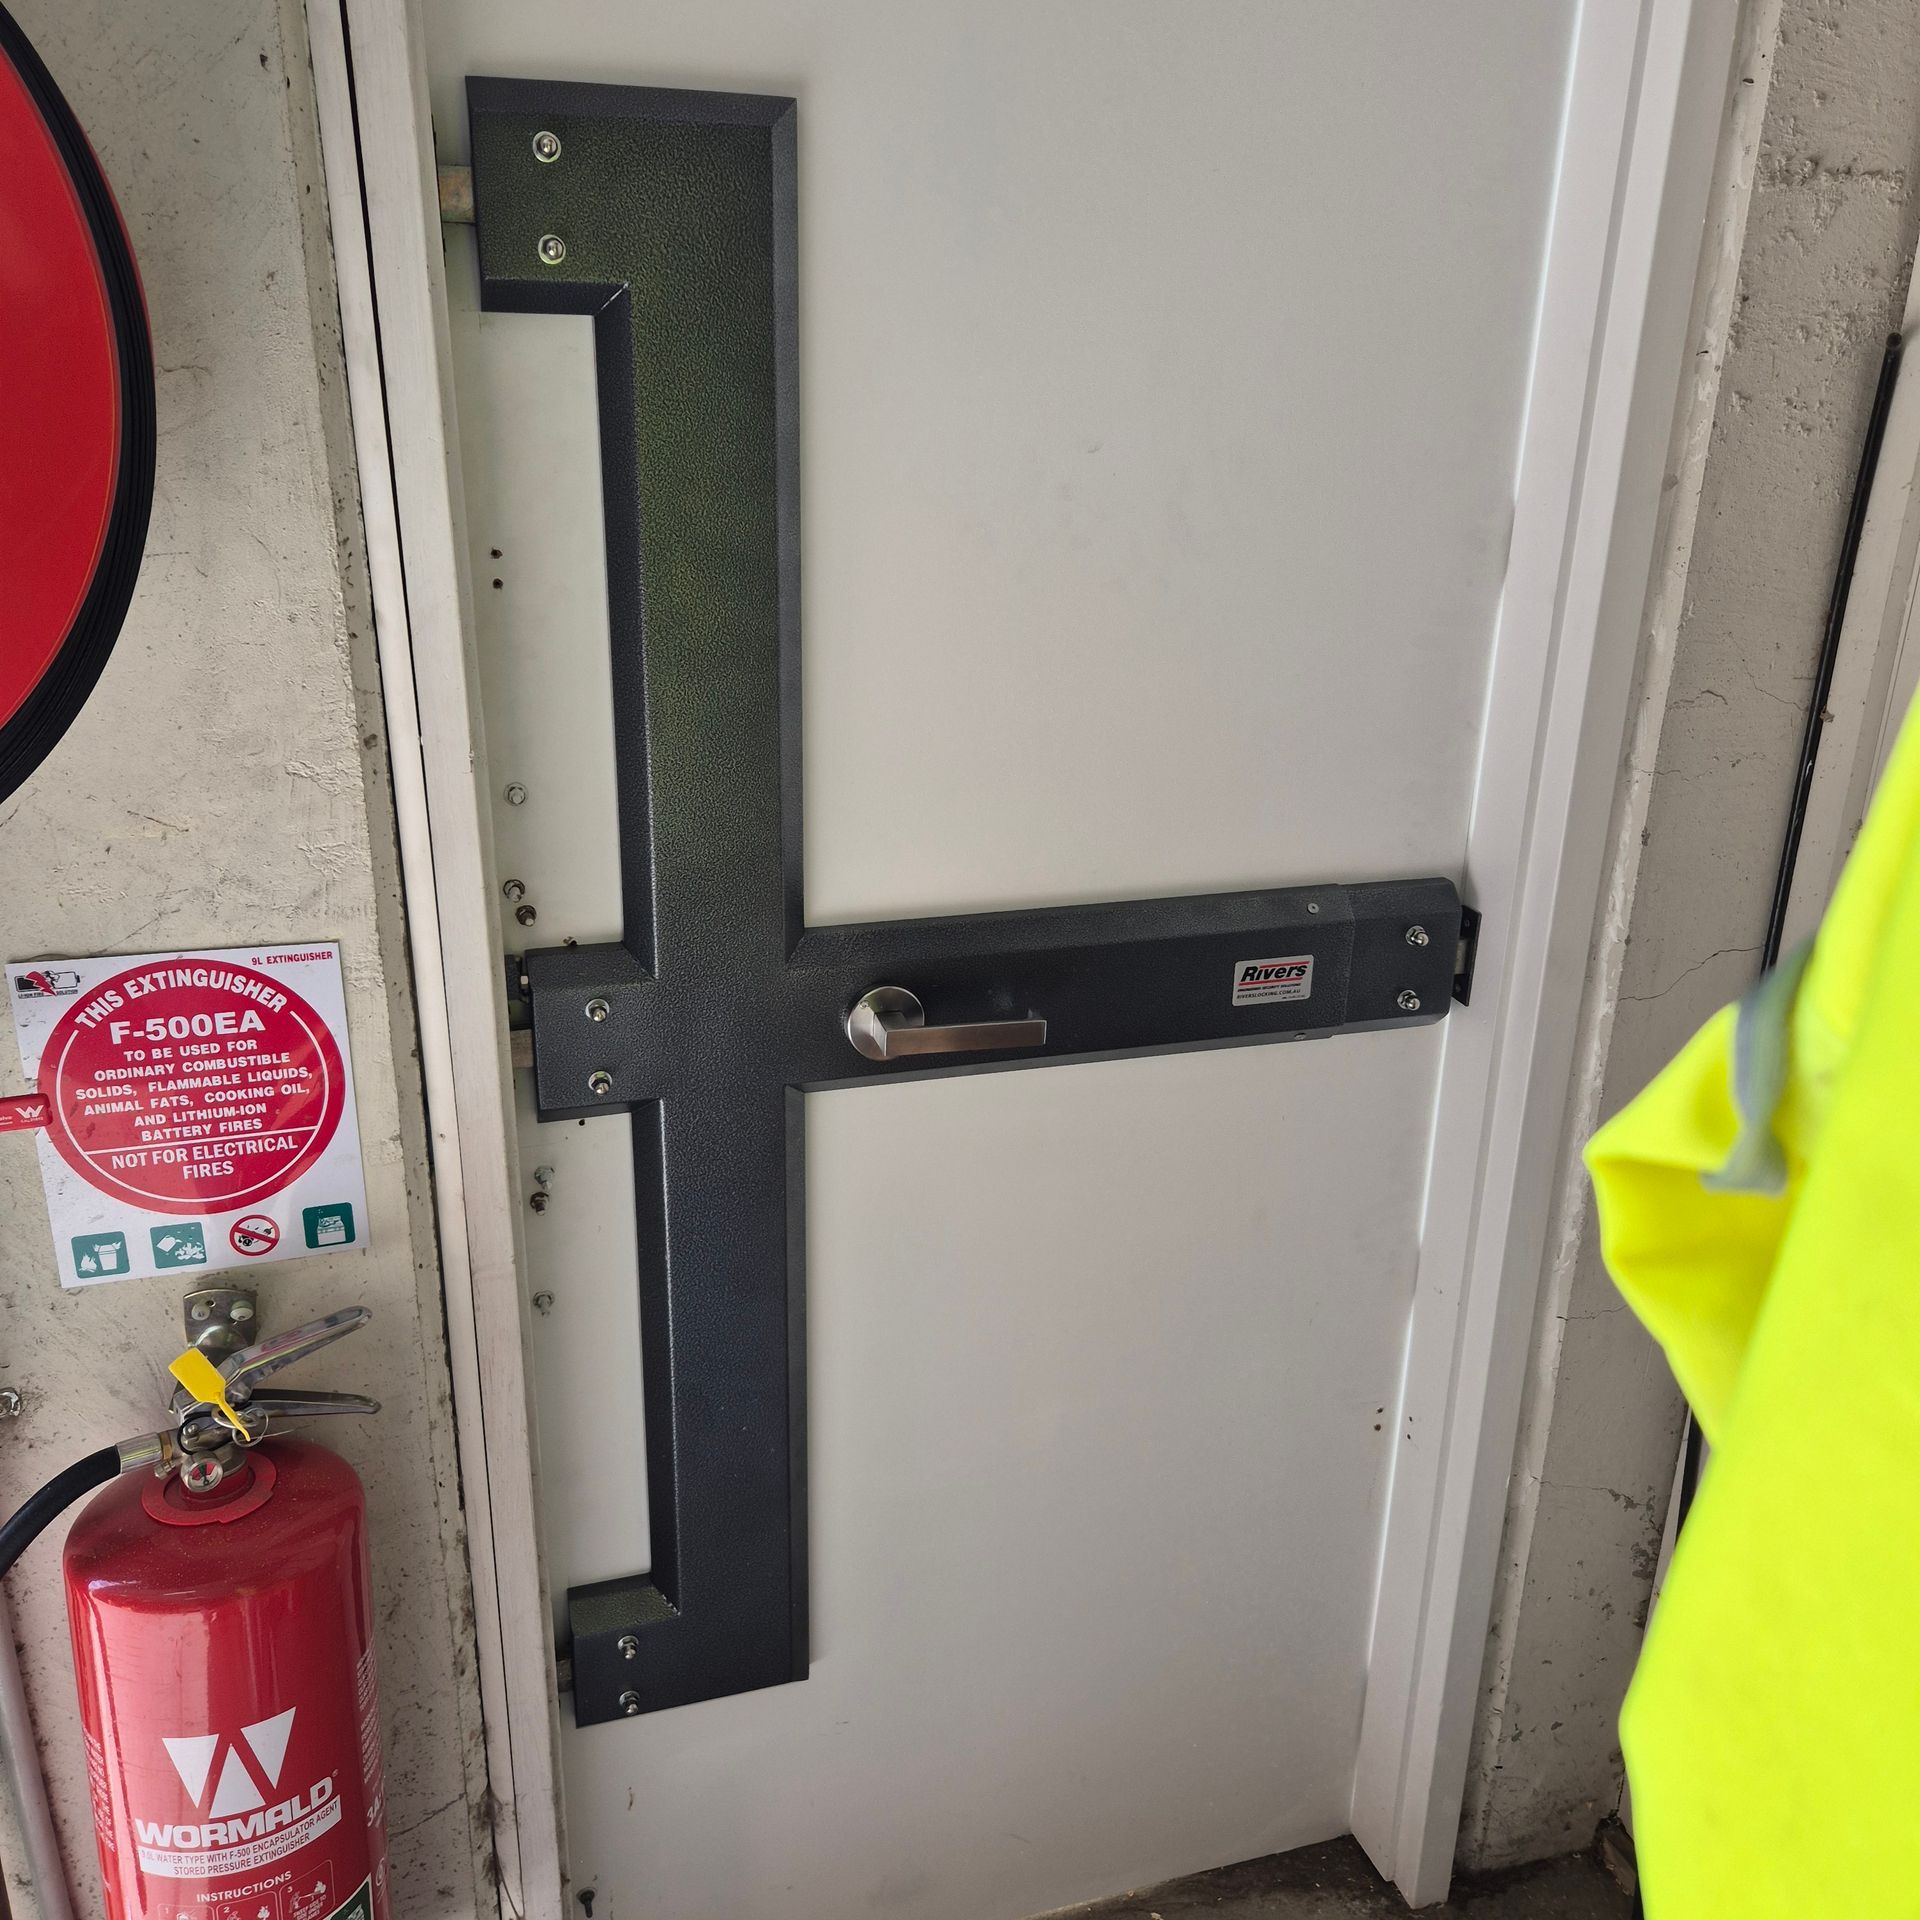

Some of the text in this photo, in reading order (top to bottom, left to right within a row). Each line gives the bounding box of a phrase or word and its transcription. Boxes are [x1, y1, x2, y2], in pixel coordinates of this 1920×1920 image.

[251, 951, 333, 966] 9L EXTINGUISHER
[1241, 965, 1307, 982] Rivers
[74, 968, 287, 1029] THIS EXTINGUISHER
[110, 1010, 266, 1045] F-500EA
[123, 1039, 258, 1062] TO BE USED FOR
[94, 1052, 291, 1082] ORDINARY COMBUSTIBLE
[75, 1067, 313, 1100] SOLIDS, FLAMMABLE LIQUIDS,
[84, 1083, 310, 1116] ANIMAL FATS, COOKING OIL,
[134, 1103, 267, 1127] AND LITHIUM-ION
[141, 1118, 263, 1142] BATTERY FIRES
[112, 1136, 298, 1170] NOT FOR ELECTRICAL
[182, 1161, 234, 1179] FIRES
[135, 1776, 332, 1848] WORMALD
[157, 1853, 183, 1865] WATER
[185, 1855, 206, 1865] TYPE
[207, 1851, 228, 1864] WITH
[229, 1847, 251, 1860] F-500
[252, 1818, 315, 1854] ENCAPSULATOR
[316, 1800, 338, 1823] AGENT
[174, 1832, 310, 1876] STORED PRESSURE EXTINGUISHER
[197, 1870, 292, 1902] INSTRUCTIONS
